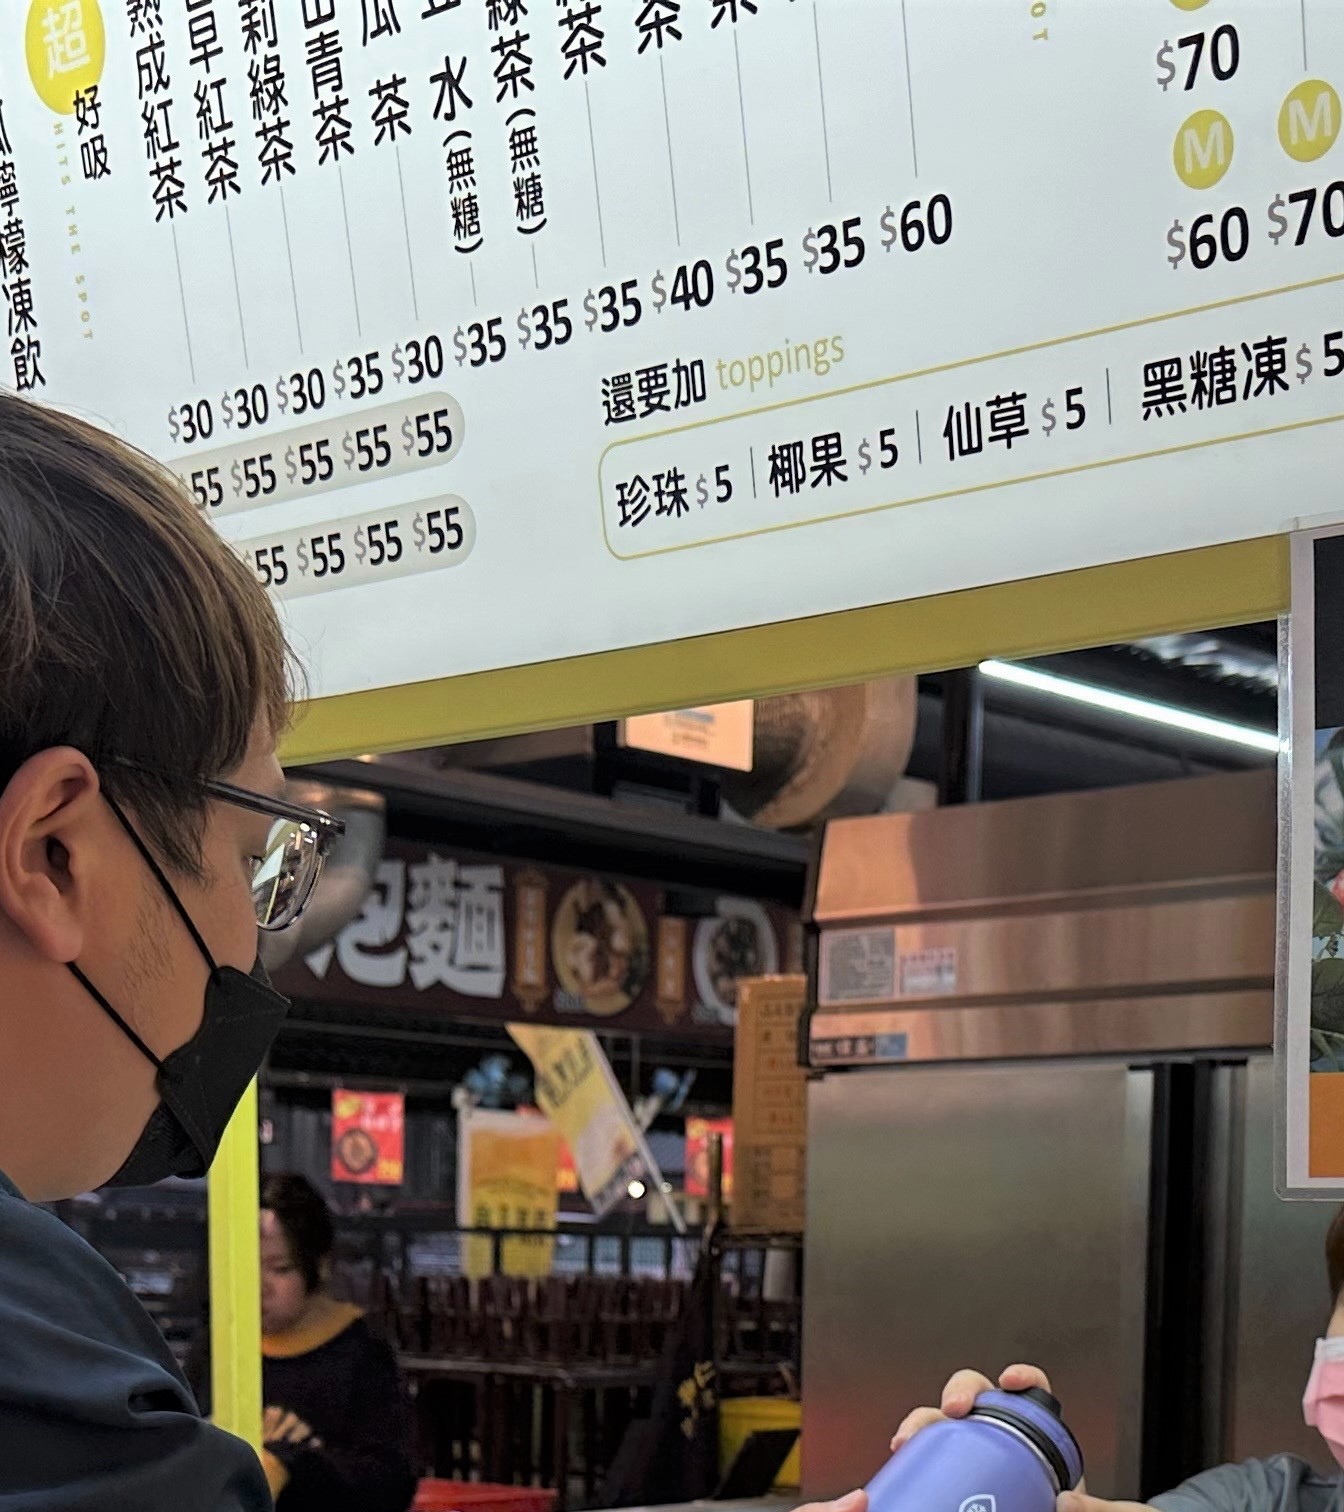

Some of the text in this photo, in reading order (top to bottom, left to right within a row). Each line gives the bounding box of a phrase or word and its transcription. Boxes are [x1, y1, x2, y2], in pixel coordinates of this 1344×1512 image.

[1156, 24, 1240, 92] $70
[184, 0, 241, 204] 早紅茶
[1288, 92, 1333, 145] M
[1183, 122, 1226, 173] M
[1166, 206, 1250, 270] $60
[167, 193, 953, 444] $30 $30 $30 $35 $30 $35 $35 $35 $40 $35 $35 $60
[600, 334, 845, 427] 還要加 toppings
[230, 453, 277, 499] $55
[284, 439, 334, 486] $55
[341, 424, 392, 472] $55
[401, 409, 452, 458] $55
[616, 466, 690, 529] 珍珠
[696, 464, 734, 511] $5
[768, 432, 848, 498] 椰果
[857, 428, 900, 475] $5
[942, 391, 1029, 461] 仙草
[1142, 335, 1290, 420] 黑糖凍
[296, 506, 464, 579] $55 $55 $55
